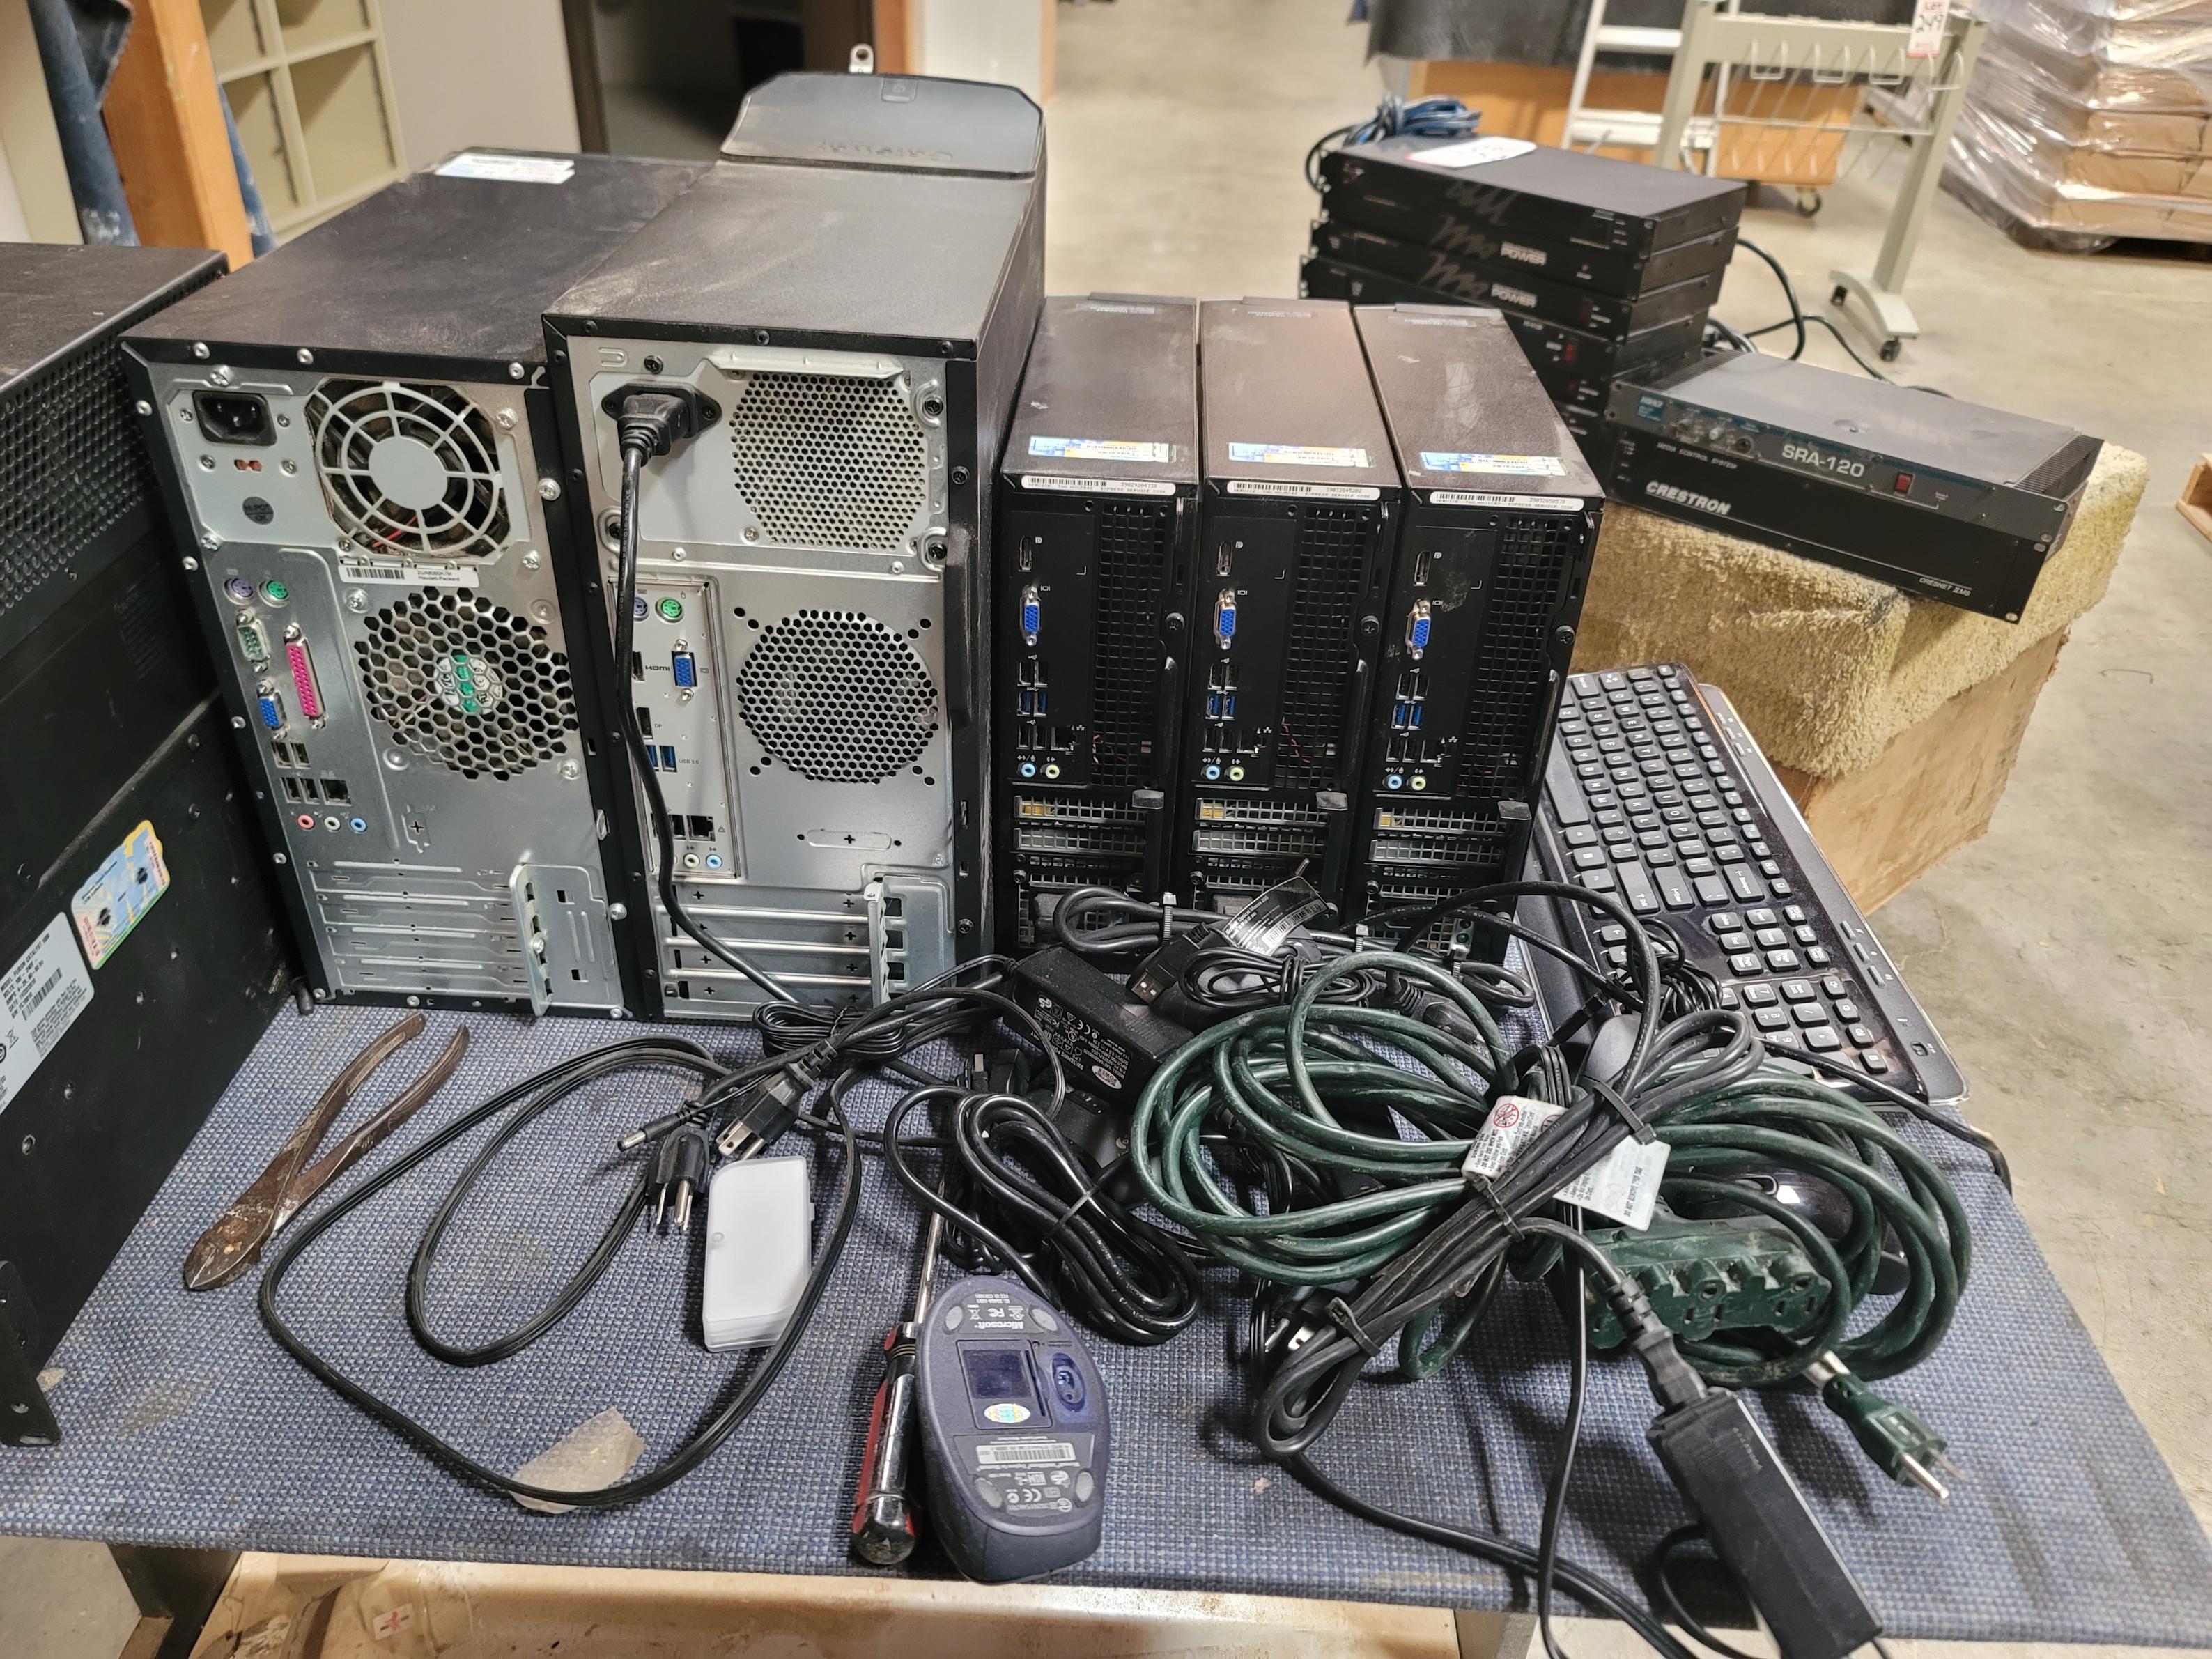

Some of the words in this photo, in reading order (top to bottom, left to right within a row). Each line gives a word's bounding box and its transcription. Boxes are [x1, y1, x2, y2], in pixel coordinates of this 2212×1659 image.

[1679, 449, 1708, 461] CONTROL
[1711, 458, 1737, 470] SYSTEM
[1782, 444, 1865, 477] SRA-120
[1646, 481, 1732, 515] CRESTRON
[418, 575, 461, 583] Hewlett-Packard
[1919, 577, 1953, 591] CRESNET
[1237, 909, 1252, 923] Optical
[1248, 900, 1262, 912] Mouse
[26, 941, 42, 963] CATALYST
[1060, 1051, 1084, 1070] SWITCHING
[1490, 1148, 1500, 1162] Children
[1634, 1166, 1643, 1175] TAG
[1627, 1185, 1638, 1202] REMOVE
[1625, 1201, 1634, 1210] NOT
